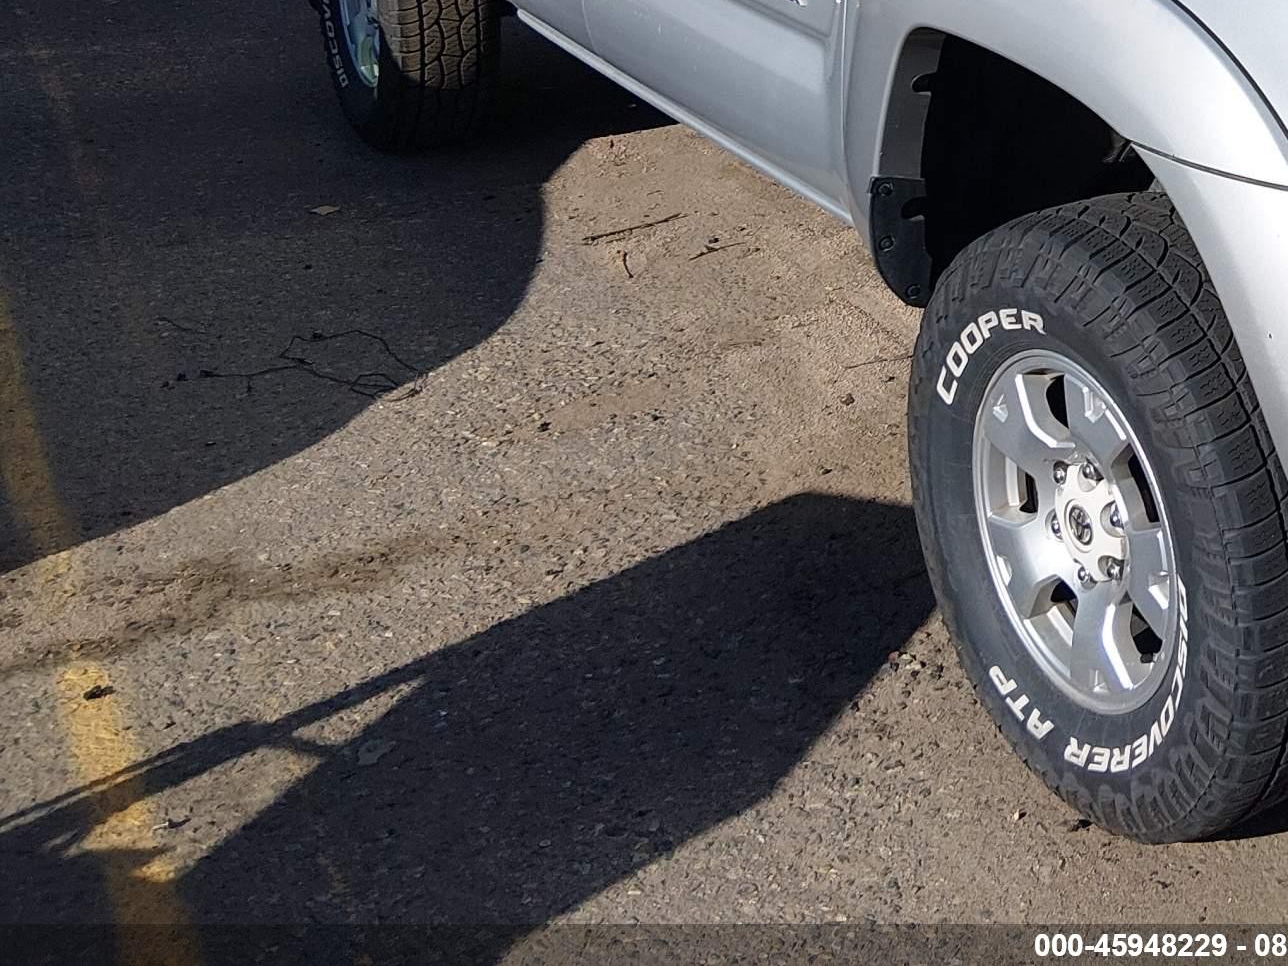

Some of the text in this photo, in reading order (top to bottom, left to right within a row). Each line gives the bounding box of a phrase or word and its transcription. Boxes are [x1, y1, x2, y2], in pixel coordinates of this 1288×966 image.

[935, 308, 1047, 406] COOPER
[988, 573, 1189, 775] DISCOVERER ATP
